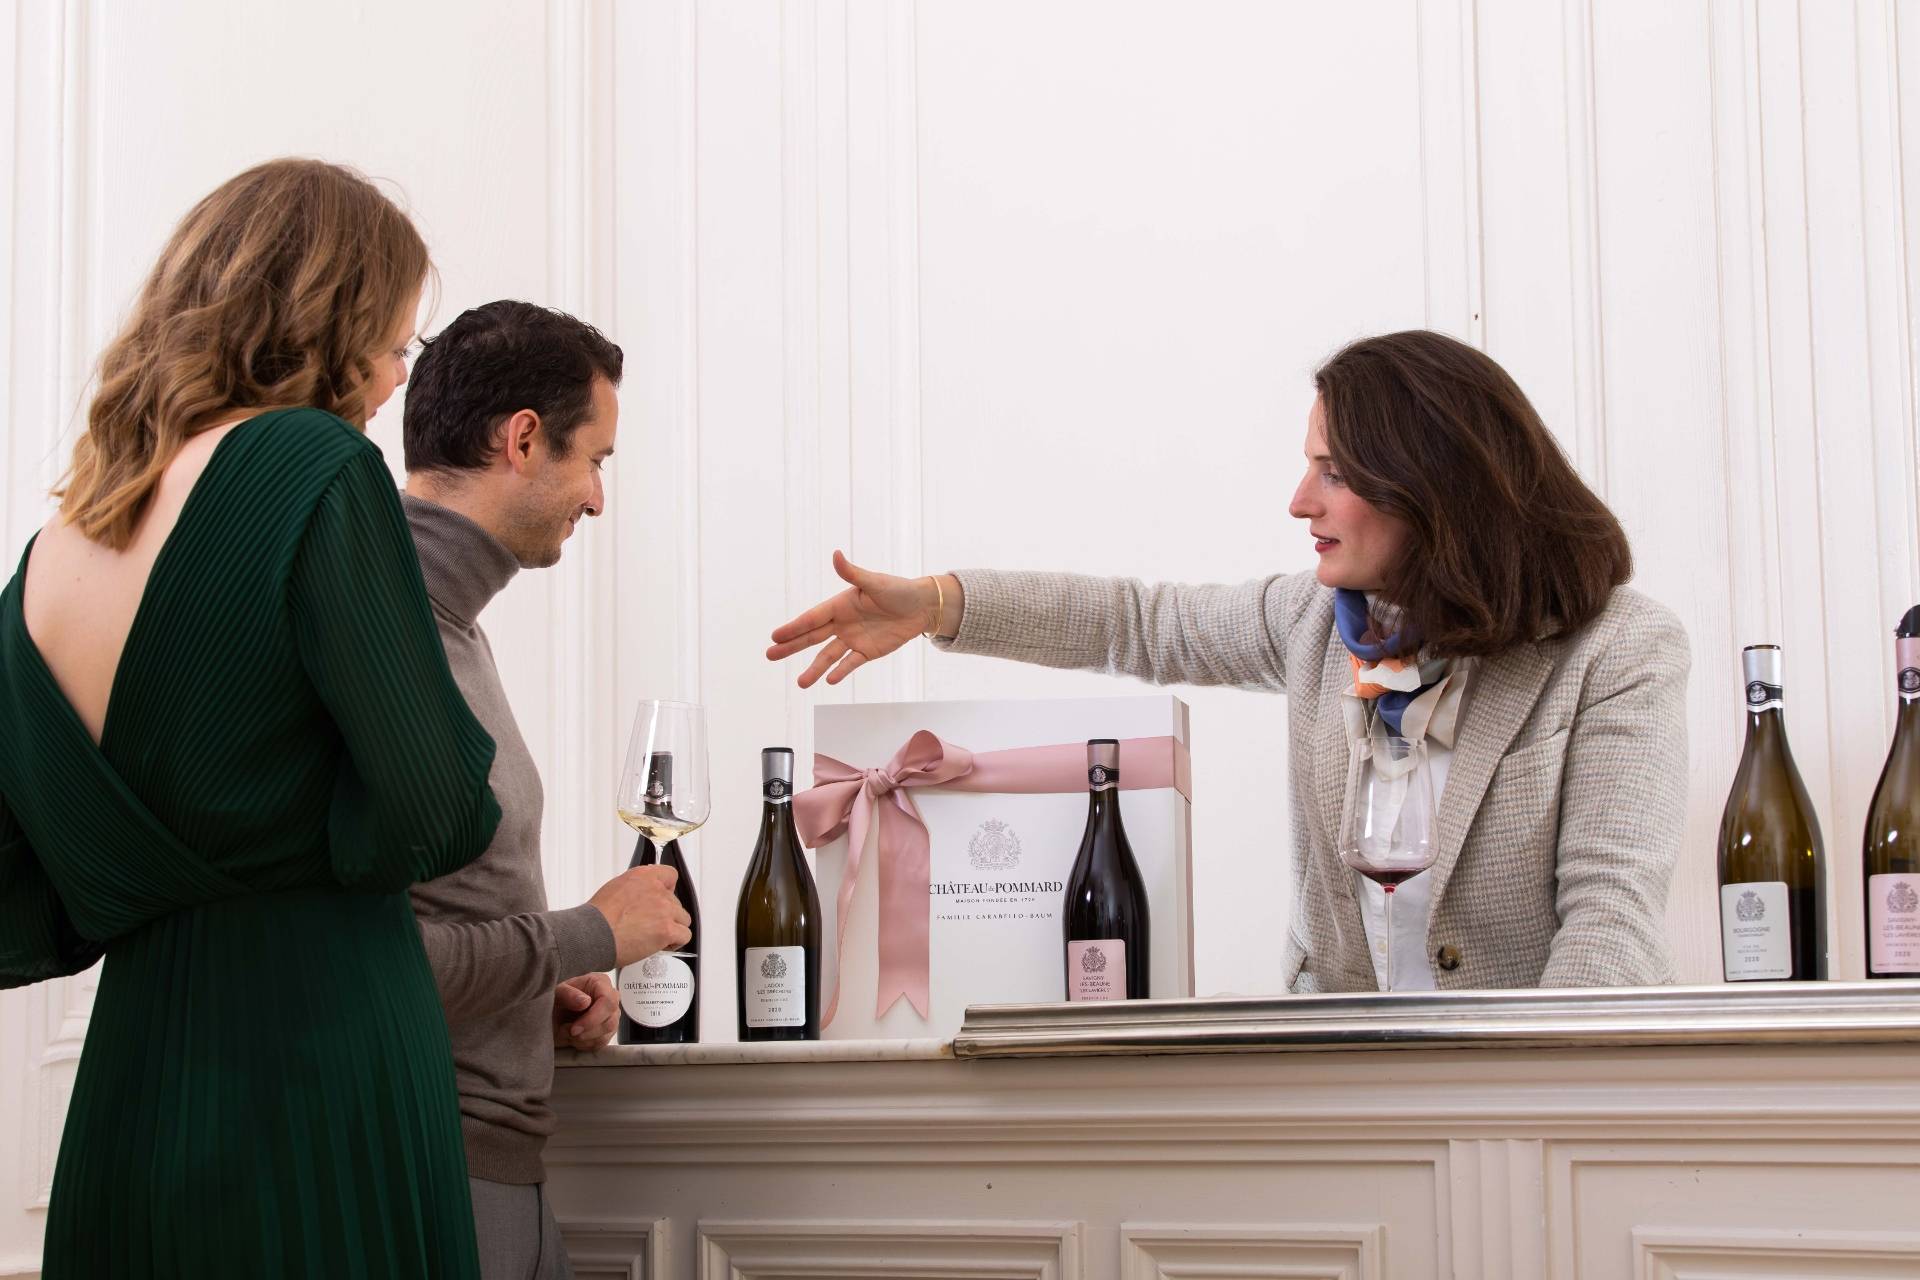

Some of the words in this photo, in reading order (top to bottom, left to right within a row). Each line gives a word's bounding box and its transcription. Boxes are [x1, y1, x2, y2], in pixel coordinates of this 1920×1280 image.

[930, 881, 988, 895] CHÂTEAU
[995, 881, 1063, 894] POMMARD
[976, 912, 1053, 920] CARABELLO-BAUM
[624, 982, 650, 990] CHÂTEAU
